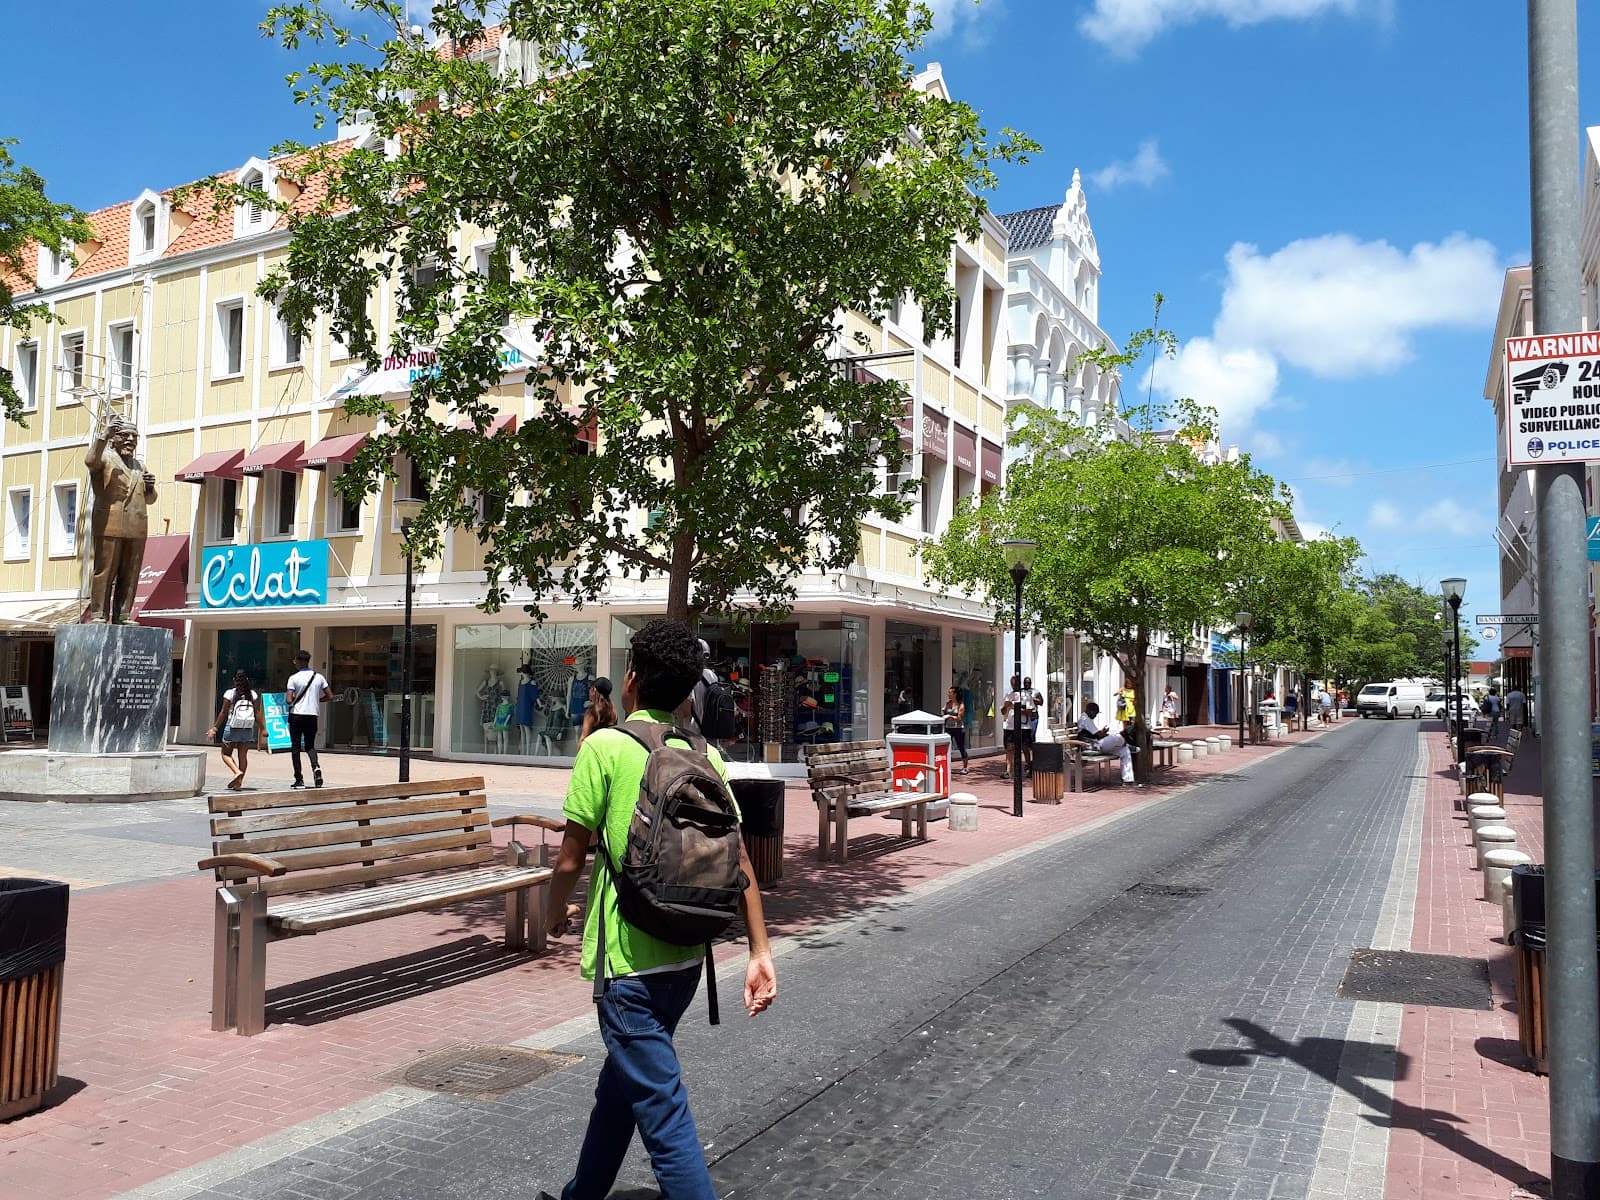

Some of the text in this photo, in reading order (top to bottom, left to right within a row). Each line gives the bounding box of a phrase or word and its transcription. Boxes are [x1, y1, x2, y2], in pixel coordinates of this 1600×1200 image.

[1508, 335, 1600, 359] WARNIN
[384, 351, 437, 371] DISFRUTA
[1521, 406, 1557, 419] VIDEO
[1548, 440, 1600, 451] POLICE
[308, 457, 328, 465] PANINI
[243, 464, 264, 473] PASTAS
[267, 705, 289, 716] SAL
